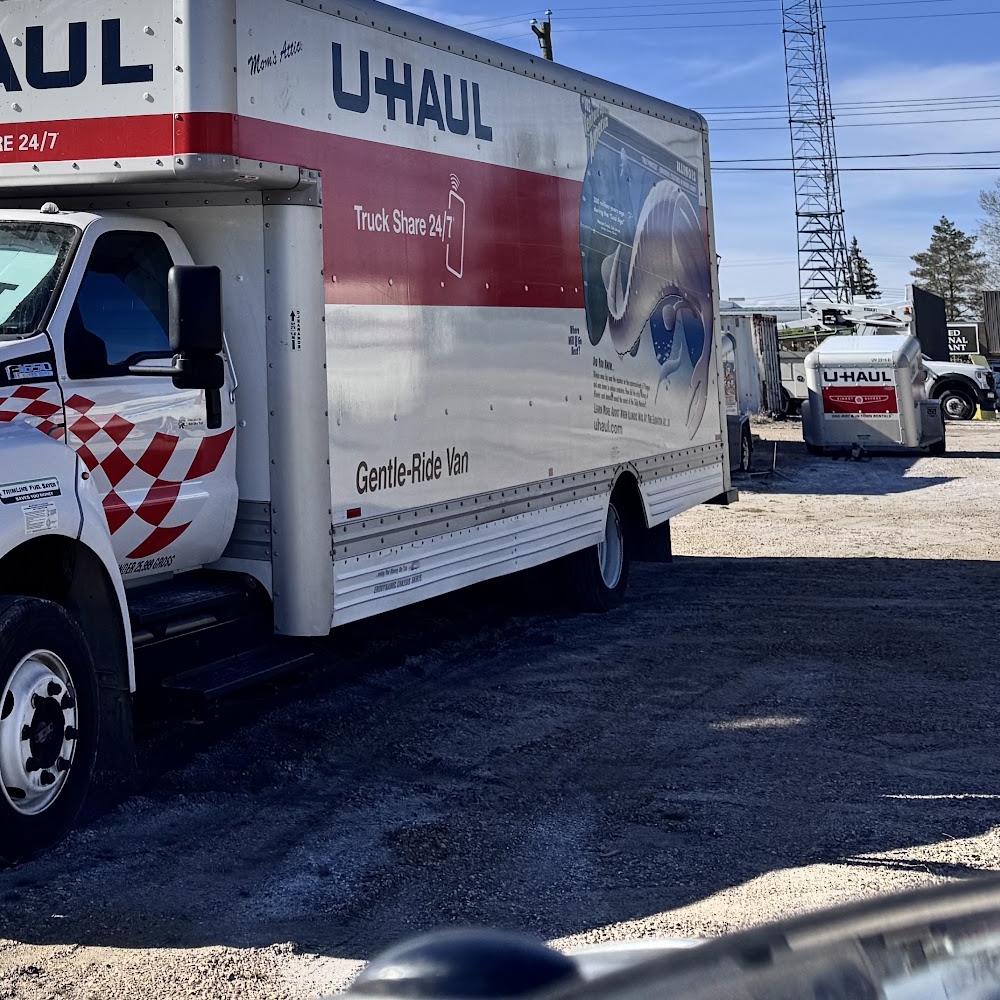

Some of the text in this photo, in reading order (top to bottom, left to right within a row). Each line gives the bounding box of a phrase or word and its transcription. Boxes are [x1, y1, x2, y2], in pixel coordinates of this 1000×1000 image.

[248, 40, 302, 76] Mom's Attic
[331, 41, 493, 142] U-HAUL
[18, 130, 58, 152] 24/7
[354, 205, 454, 242] Truck Share 24/7
[824, 372, 892, 382] U-HAUL
[594, 418, 623, 434] uhaul.com
[356, 446, 468, 494] Gentle-Ride Van
[119, 562, 136, 575] NDER
